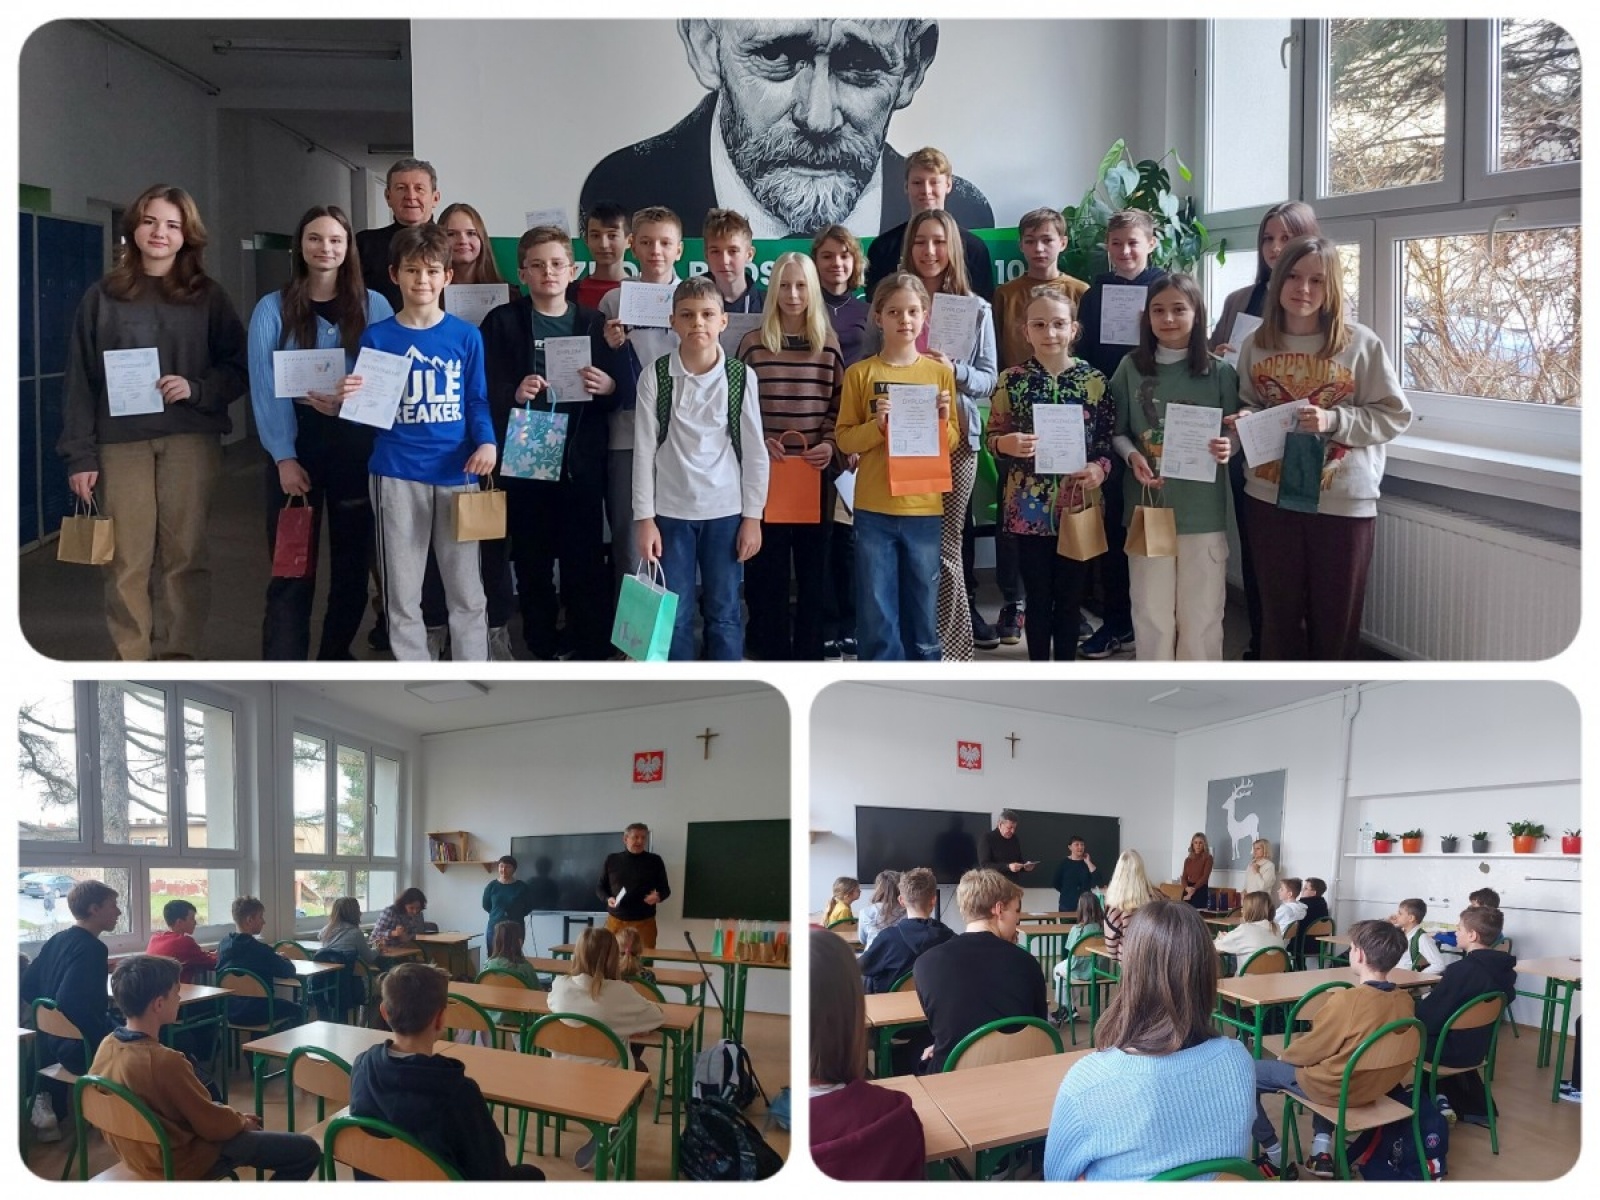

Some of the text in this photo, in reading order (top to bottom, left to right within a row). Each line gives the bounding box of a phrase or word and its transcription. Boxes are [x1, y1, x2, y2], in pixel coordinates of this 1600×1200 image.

[994, 259, 1026, 285] 10
[402, 369, 462, 405] ULE
[395, 403, 463, 424] REAKER
